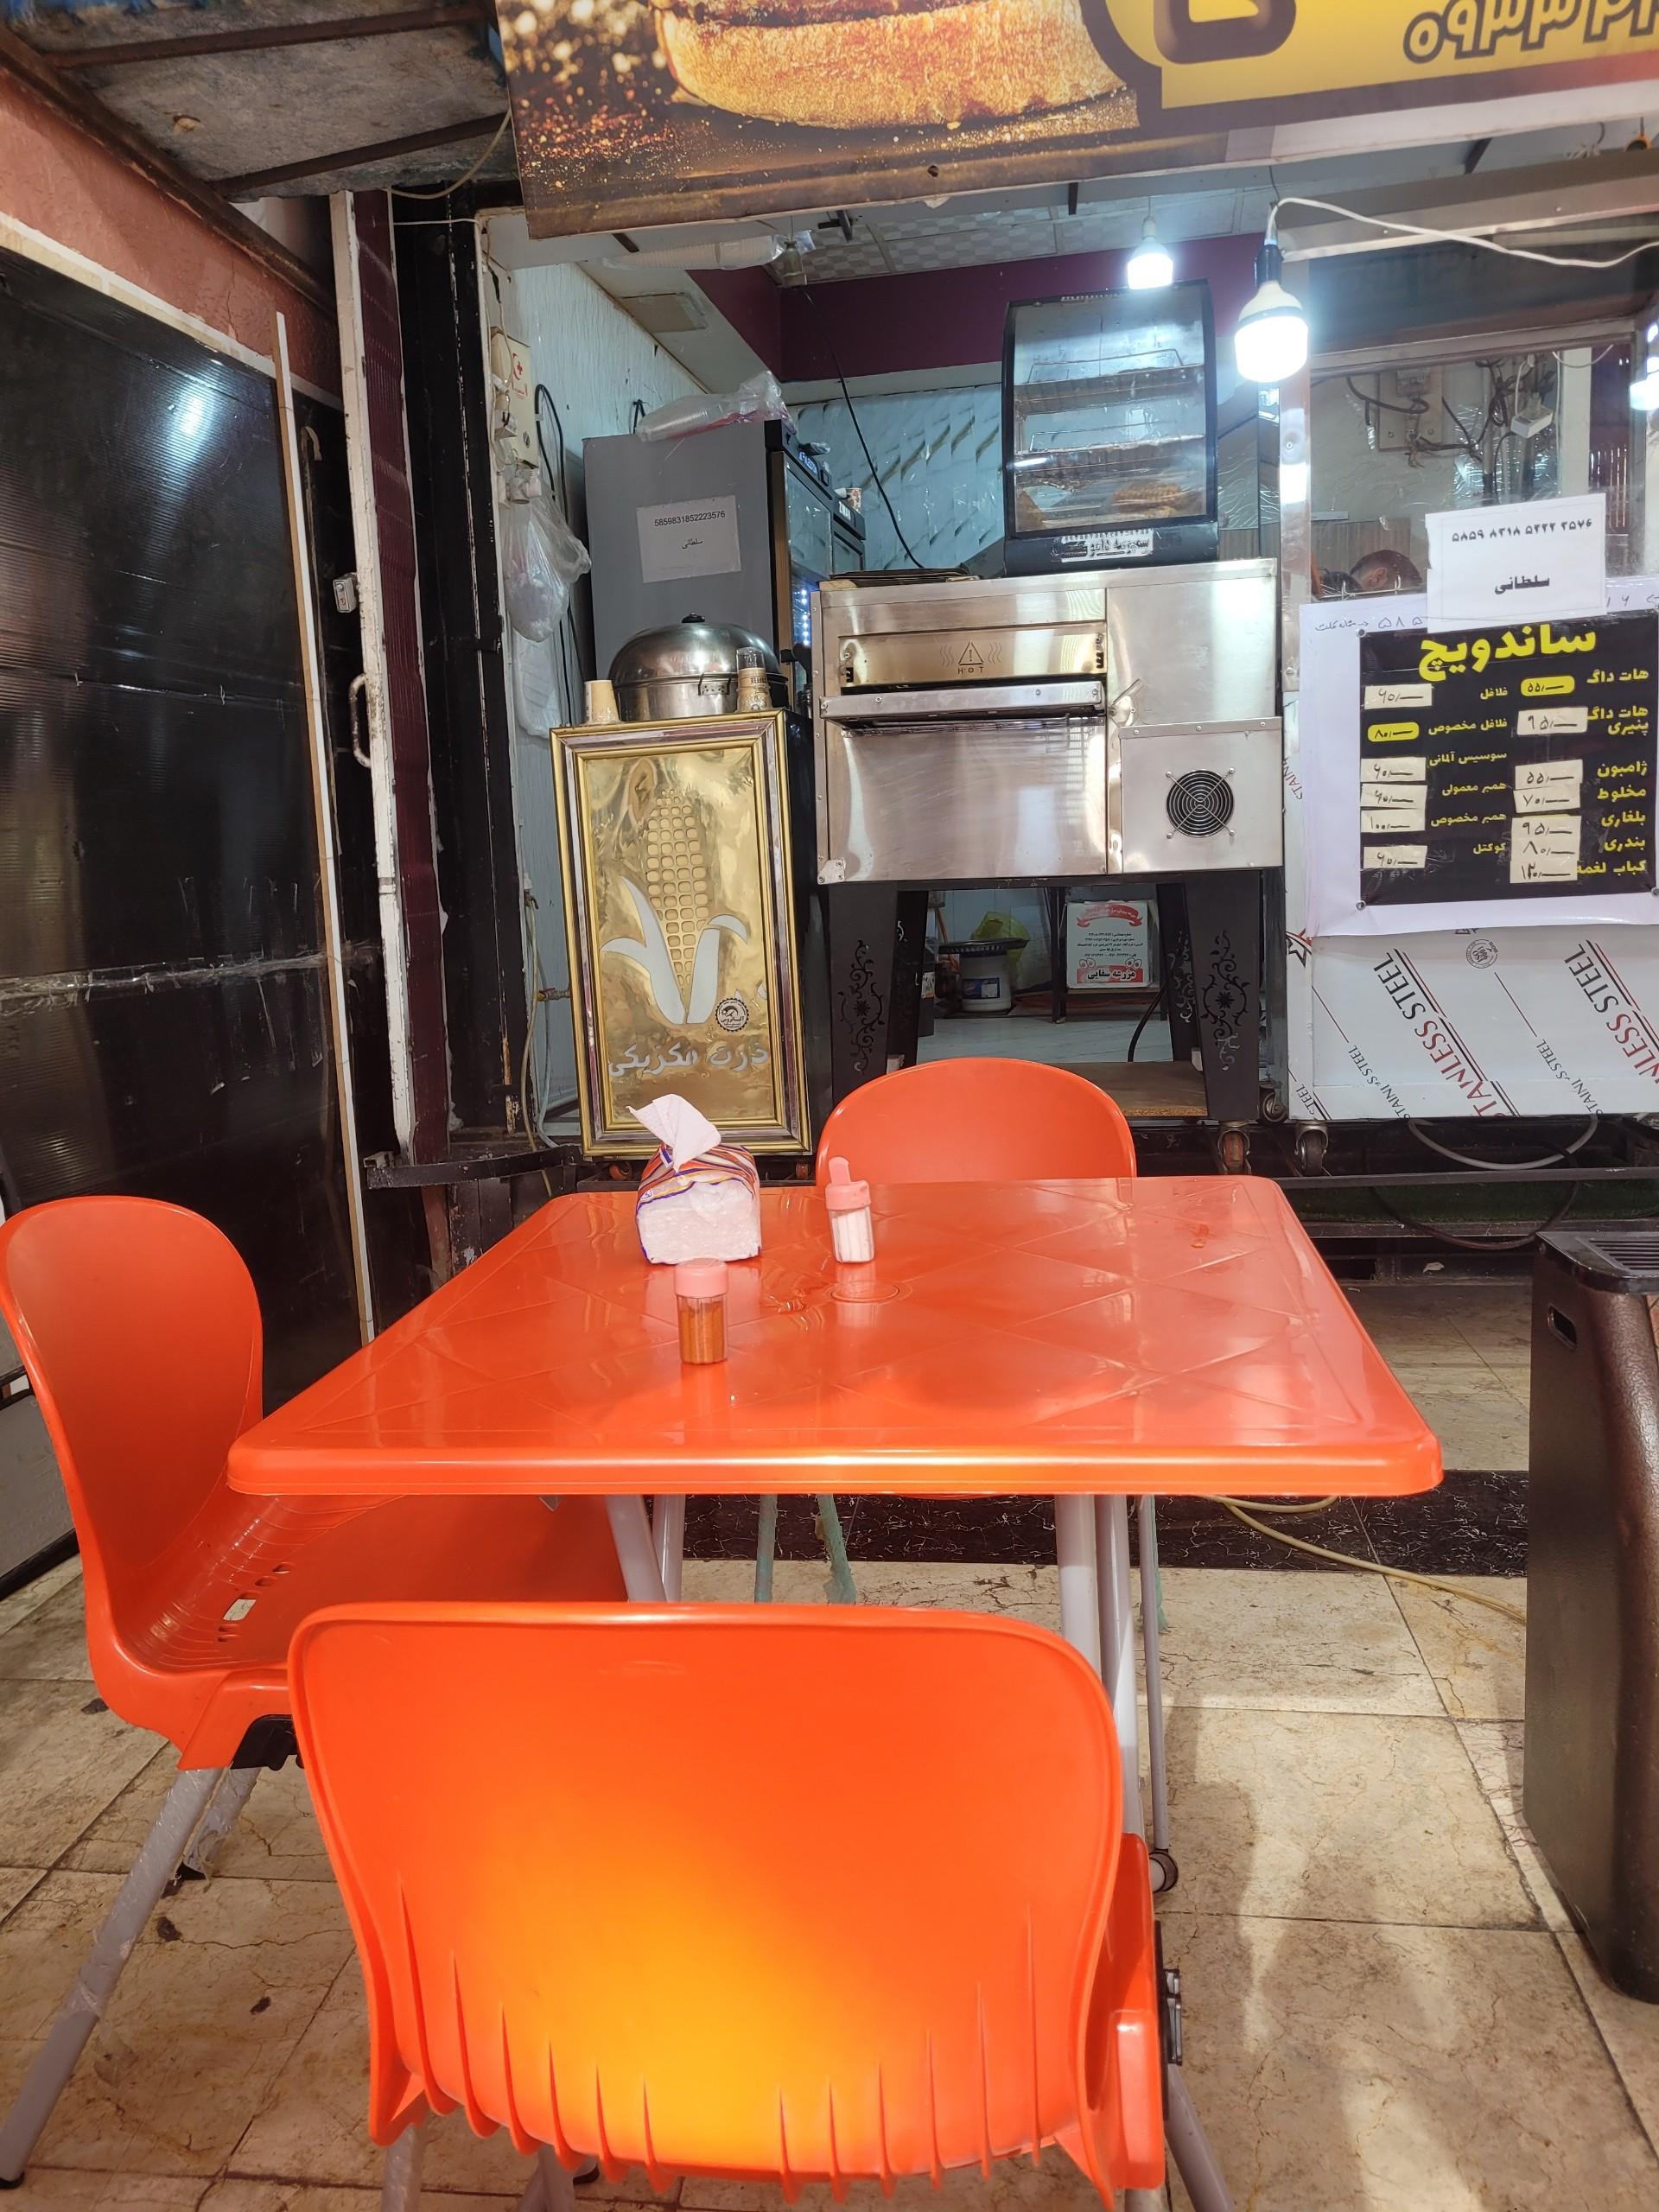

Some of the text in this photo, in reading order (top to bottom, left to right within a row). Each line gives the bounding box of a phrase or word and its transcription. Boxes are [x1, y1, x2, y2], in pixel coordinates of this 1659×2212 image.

[654, 510, 725, 527] 5859831852223576
[1452, 529, 1484, 543] ۵۸۵۹
[1494, 575, 1550, 595] سلطانی
[1419, 624, 1597, 683] ساندویچ
[1586, 668, 1649, 683] هات داگ
[1480, 687, 1509, 701] فلافل
[1587, 705, 1649, 721] هات داگ
[1428, 719, 1508, 735] فلافل مخصوص
[1607, 719, 1649, 736] پنیری
[1429, 751, 1508, 766] سوسیس آلمانی
[1597, 760, 1648, 778] ژامبون
[1441, 782, 1508, 797] همبر معمولی
[1597, 785, 1647, 803] مخلوط
[1430, 812, 1507, 827] همبر مخصوص
[1600, 810, 1646, 828] بلغاری
[1472, 842, 1506, 855] کوکتل
[1603, 836, 1646, 853] بندری
[1613, 859, 1647, 876] کباب
[1373, 952, 1426, 1020] STEEL
[1564, 944, 1619, 1013] STEEL
[1348, 1045, 1373, 1077] STEEL
[1536, 1039, 1562, 1071] STEEL
